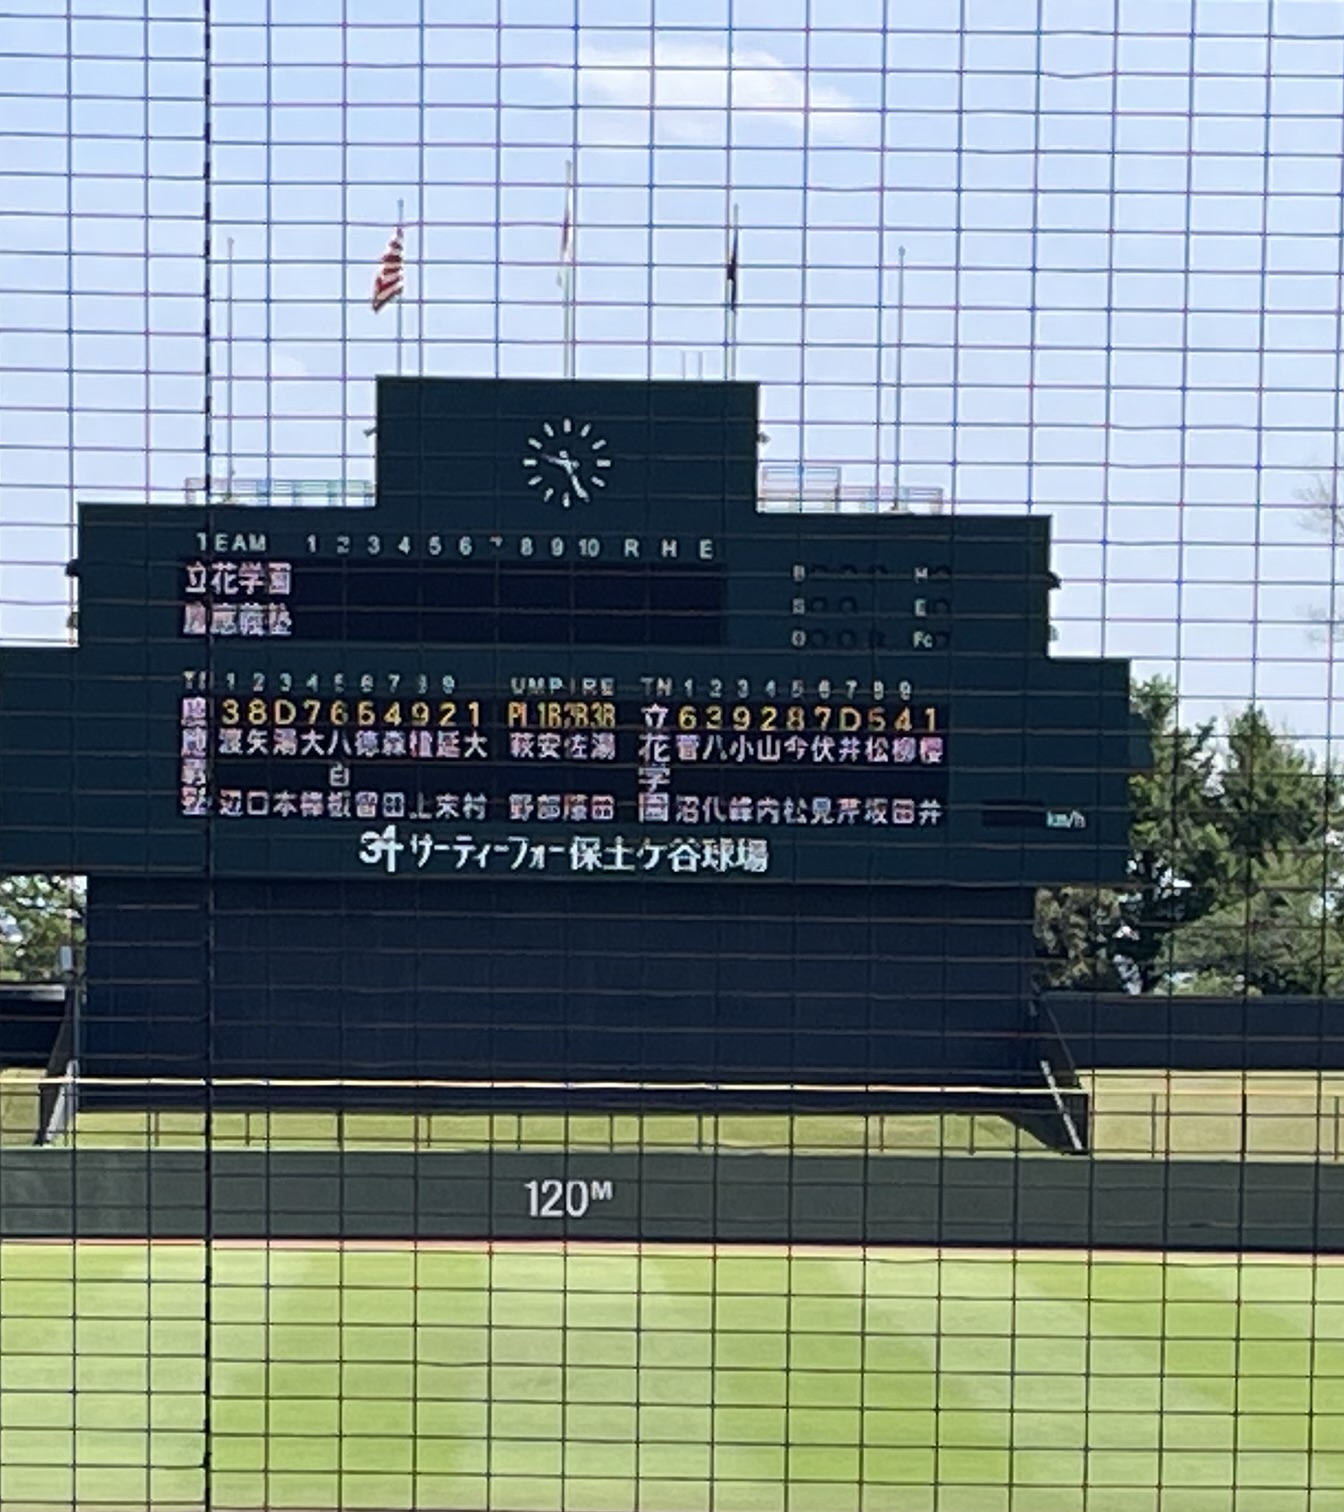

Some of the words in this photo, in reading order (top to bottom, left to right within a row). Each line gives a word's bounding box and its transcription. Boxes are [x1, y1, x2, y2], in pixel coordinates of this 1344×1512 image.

[196, 532, 267, 551] TEAM
[307, 535, 317, 552] 1
[336, 536, 350, 553] 2
[367, 535, 381, 554] 3
[397, 536, 411, 554] 4
[428, 536, 442, 555] 5
[459, 536, 473, 556] 6
[520, 537, 534, 557] 8
[551, 537, 564, 557] 9
[578, 538, 601, 558] 10
[624, 538, 640, 558] R
[661, 539, 677, 558] H
[699, 540, 713, 559] E
[185, 561, 292, 595] 立花学園
[511, 677, 615, 696] UMPIRE
[684, 678, 693, 697] 1
[709, 678, 722, 698] 2
[737, 678, 749, 699] 3
[765, 679, 775, 699] 4
[819, 679, 830, 699] 6
[846, 680, 857, 700] 7
[873, 680, 884, 700] 8
[899, 681, 912, 701] 9
[222, 698, 239, 725] 3
[248, 698, 268, 725] 8
[274, 699, 296, 725] D
[303, 699, 321, 725] 7
[330, 700, 348, 725] 6
[383, 701, 402, 726] 4
[411, 702, 430, 726] 9
[438, 702, 457, 726] 2
[468, 702, 480, 727] 1
[678, 705, 697, 730] 6
[706, 705, 723, 730] 3
[733, 706, 751, 731] 9
[760, 706, 778, 731] 2
[786, 706, 805, 731] 8
[814, 706, 831, 732] 7
[839, 706, 862, 732] D
[868, 707, 887, 732] 5
[894, 707, 913, 732] 4
[925, 707, 936, 732] 1
